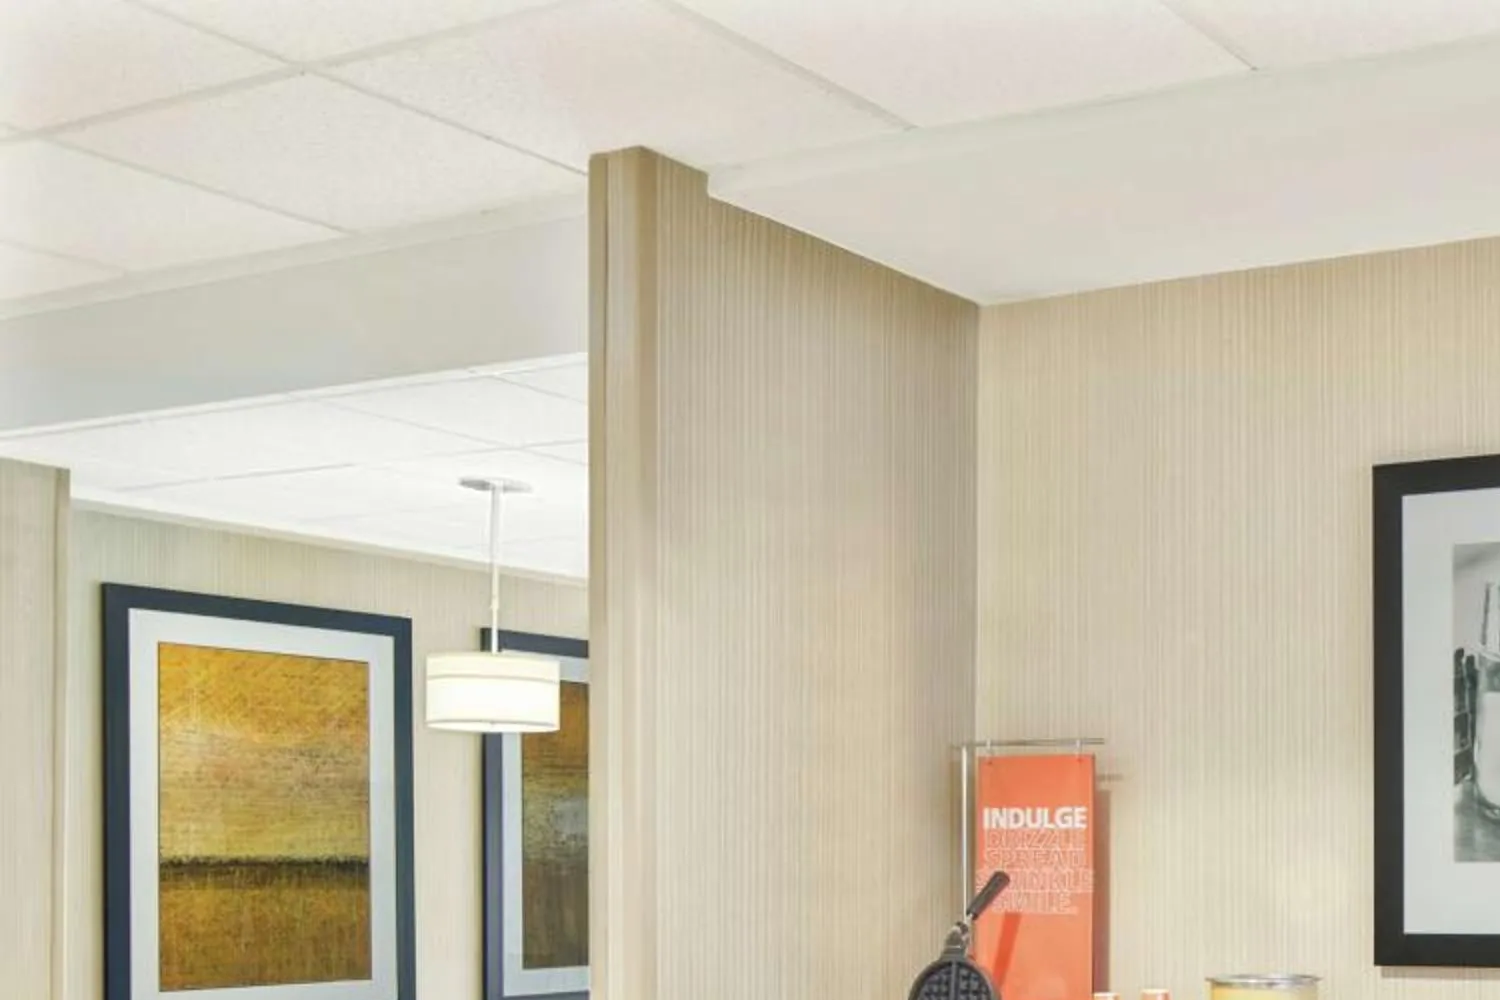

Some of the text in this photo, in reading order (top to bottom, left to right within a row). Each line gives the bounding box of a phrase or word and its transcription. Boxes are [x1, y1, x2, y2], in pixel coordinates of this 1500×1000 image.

[982, 806, 1088, 829] INDULGE
[985, 829, 1085, 850] DRIZZLE
[983, 849, 1088, 870] SPREAD
